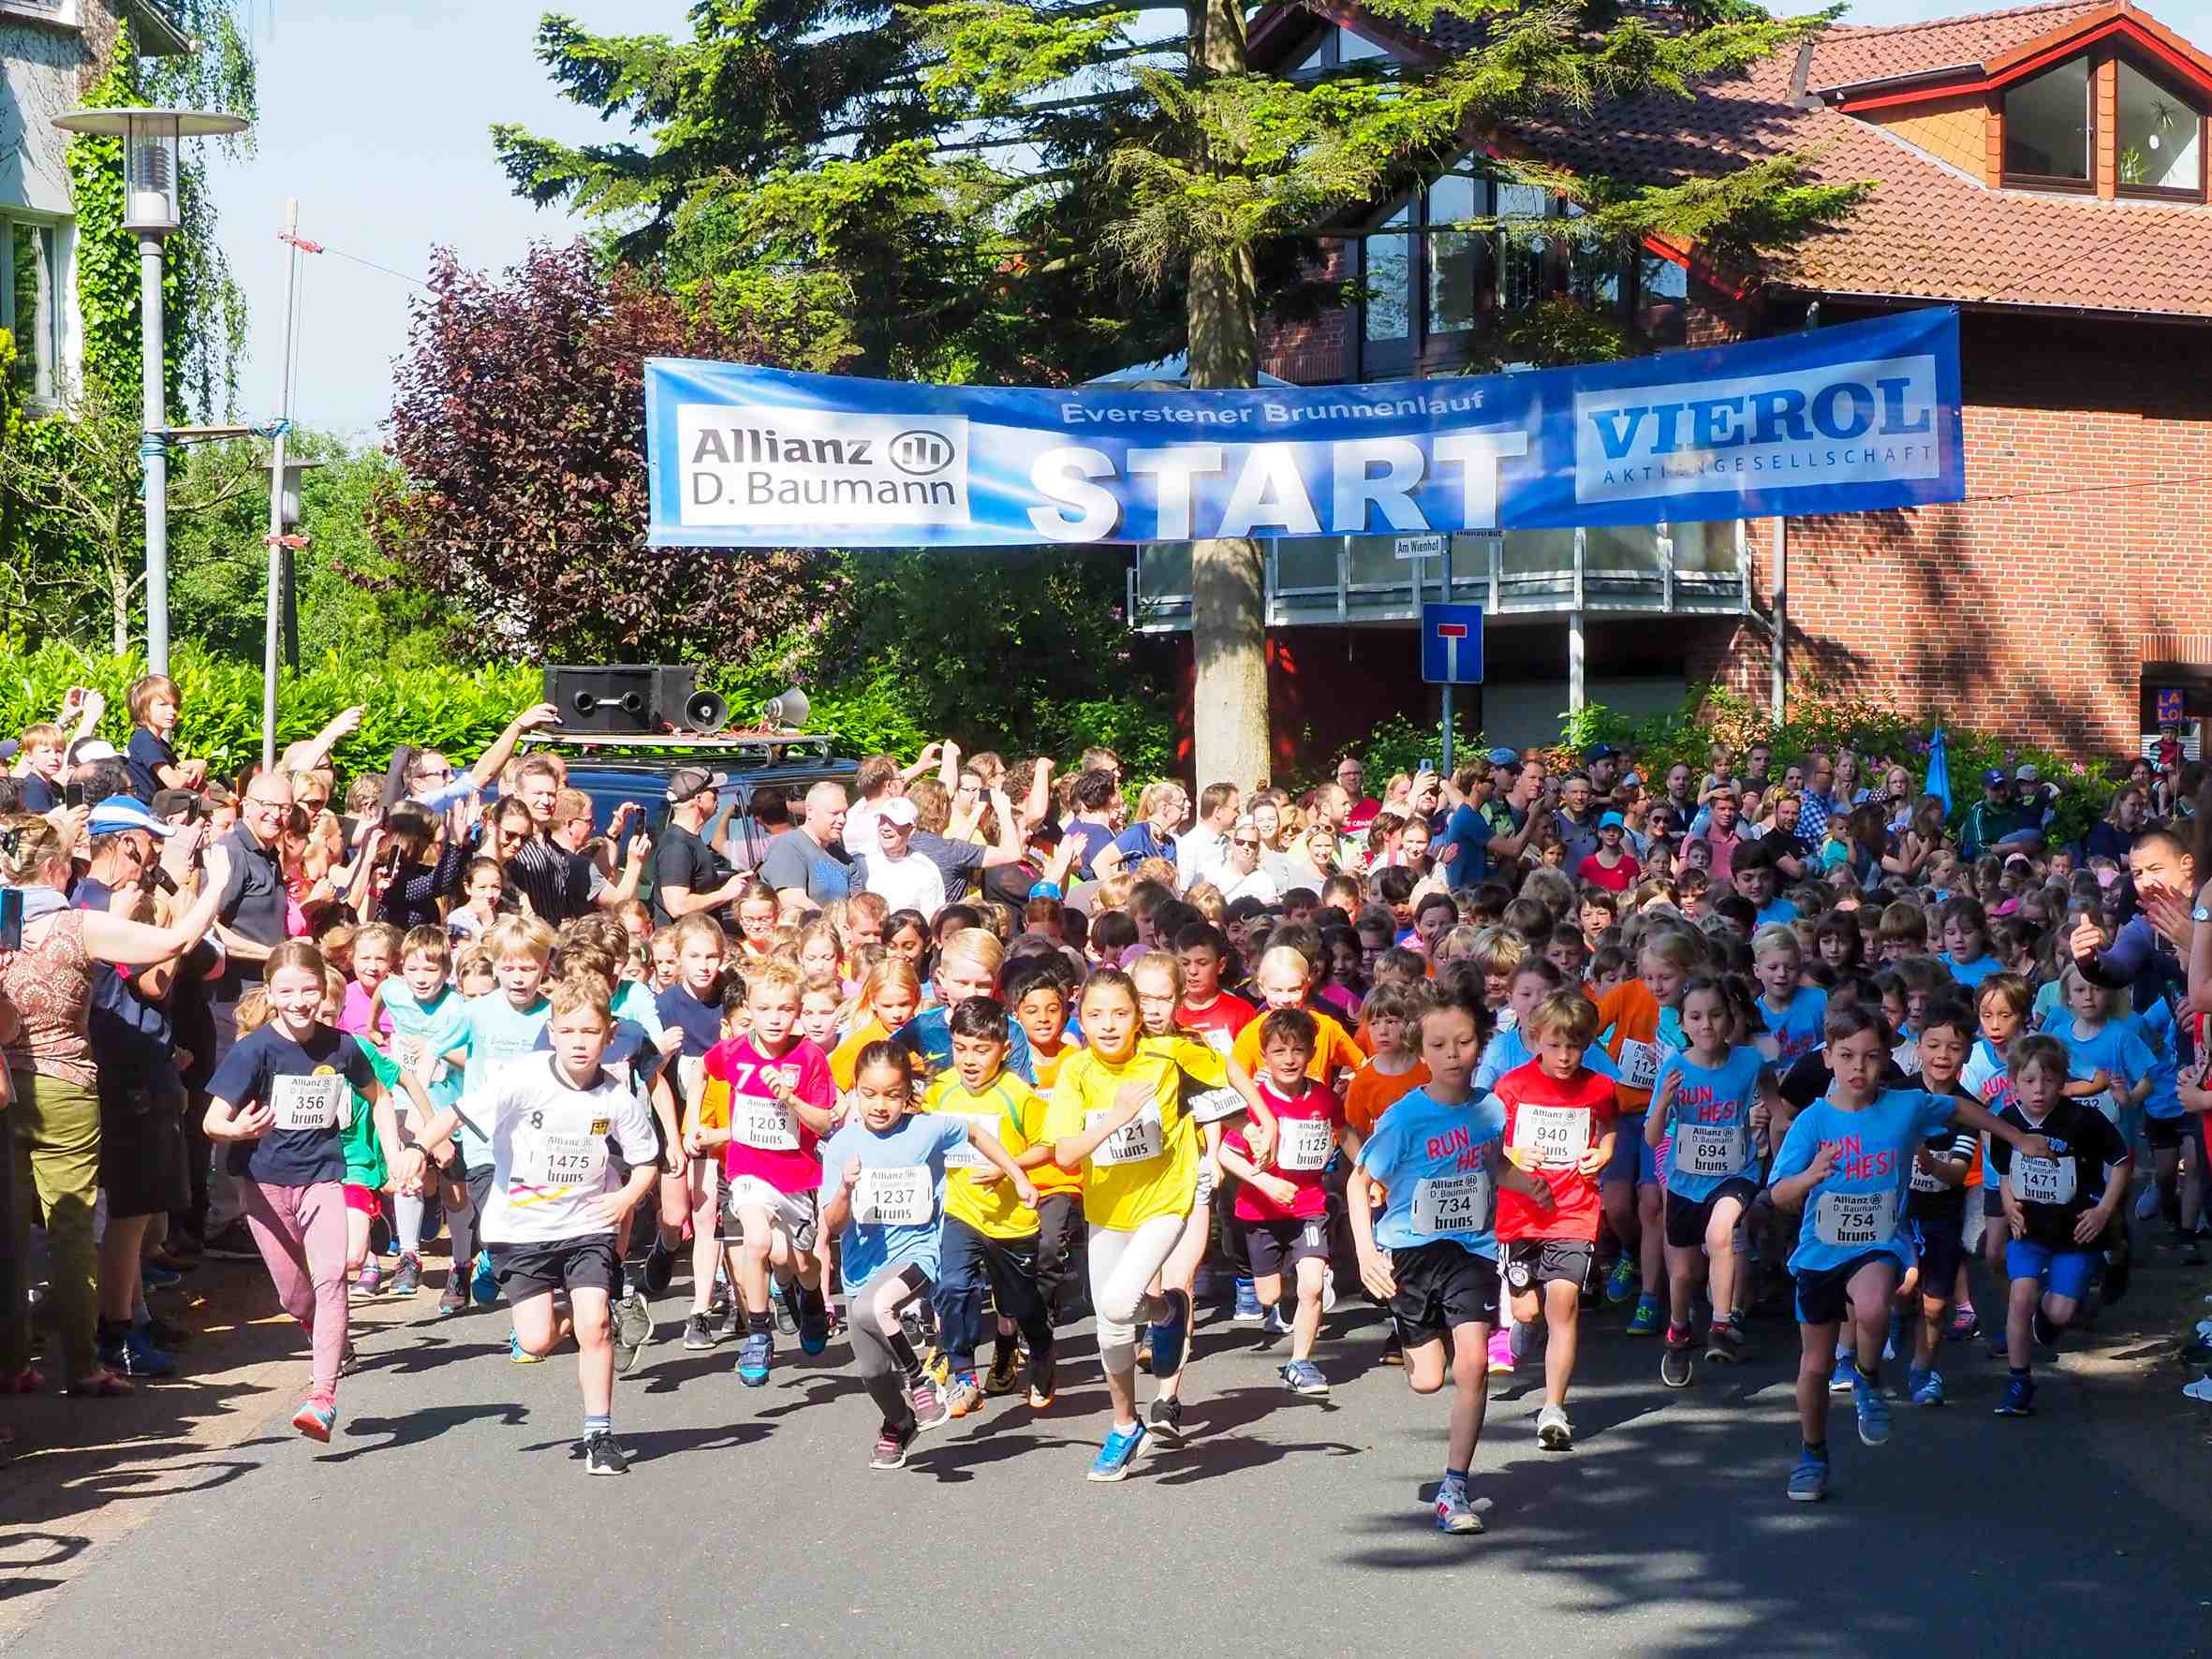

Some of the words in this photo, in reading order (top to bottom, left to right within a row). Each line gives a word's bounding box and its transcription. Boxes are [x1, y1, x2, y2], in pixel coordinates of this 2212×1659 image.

[1062, 403, 1252, 424] Everstener
[1264, 390, 1485, 422] Brunnenlauf
[1588, 377, 1933, 461] VIEROL
[692, 428, 873, 465] Allianz
[1603, 445, 1932, 485] AKTIENGESELLSCHAFT
[692, 471, 735, 506] D.
[748, 471, 956, 506] Baumann
[1026, 432, 1528, 542] START
[1398, 542, 1409, 554] Am
[1410, 539, 1439, 554] Wienhof
[292, 1078, 321, 1087] Allianz
[736, 1064, 756, 1089] 7
[1631, 1071, 1656, 1088] brun
[296, 1096, 324, 1109] 356
[1214, 1093, 1243, 1112] bruns
[291, 1111, 324, 1124] bruns
[531, 1111, 543, 1129] 8
[1532, 1108, 1562, 1119] Allianz
[749, 1116, 787, 1131] 1203
[750, 1130, 783, 1145] bruns
[1537, 1127, 1568, 1142] 940
[1693, 1127, 1722, 1137] Allianz
[1298, 1138, 1327, 1152] 1125
[1426, 1123, 1470, 1161] RUN
[1109, 1143, 1149, 1160] bruns
[1699, 1144, 1727, 1157] 694
[548, 1154, 590, 1169] 1475
[1296, 1153, 1323, 1166] bruns
[1695, 1158, 1729, 1171] bruns
[548, 1168, 583, 1183] bruns
[2023, 1172, 2057, 1187] 1471
[1430, 1179, 1464, 1189] Allianz
[872, 1190, 915, 1204] 1237
[1440, 1186, 1478, 1198] Baumann
[2025, 1185, 2057, 1200] bruns
[1438, 1197, 1471, 1214] 734
[1834, 1195, 1869, 1205] Allianz
[875, 1205, 912, 1219] bruns
[1841, 1212, 1875, 1227] 754
[1435, 1215, 1473, 1230] bruns
[1304, 1226, 1320, 1248] 10
[1837, 1227, 1877, 1242] bruns
